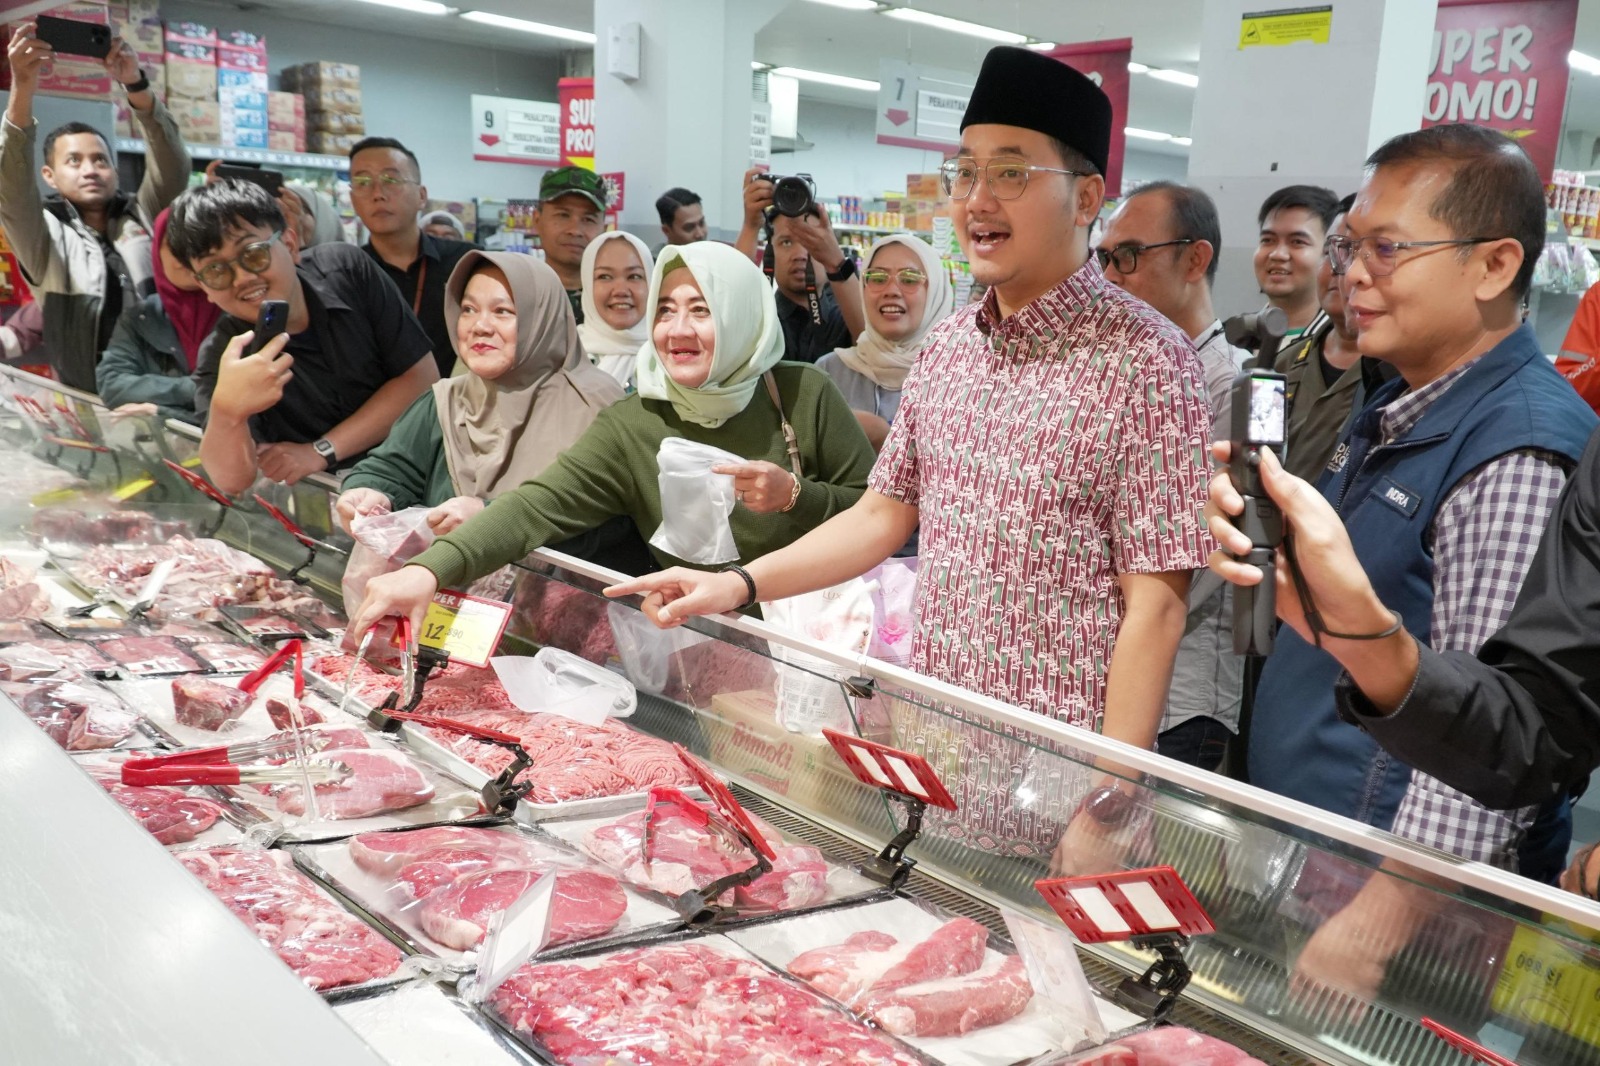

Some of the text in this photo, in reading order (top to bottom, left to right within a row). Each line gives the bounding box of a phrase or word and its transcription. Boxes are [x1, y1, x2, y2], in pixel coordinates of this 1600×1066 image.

[896, 77, 906, 102] 7
[485, 111, 494, 128] 9
[565, 127, 595, 152] PRO
[809, 294, 821, 325] SONY
[822, 590, 842, 600] LUX
